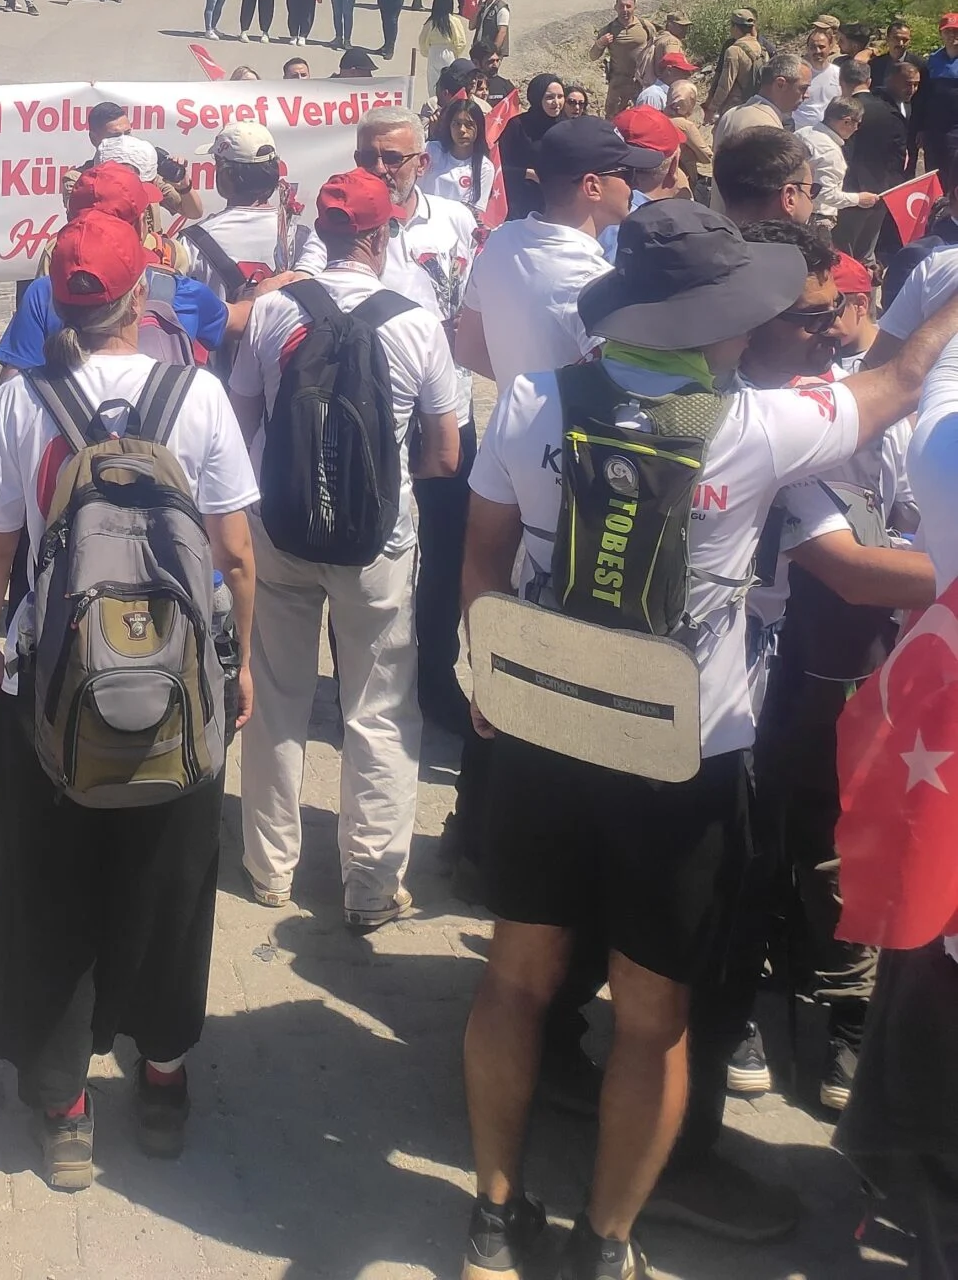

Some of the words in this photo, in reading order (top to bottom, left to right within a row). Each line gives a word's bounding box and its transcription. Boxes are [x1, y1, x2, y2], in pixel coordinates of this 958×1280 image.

[176, 96, 269, 135] Şeref
[535, 673, 579, 697] DECATHLON
[613, 697, 660, 717] DECATHLON
